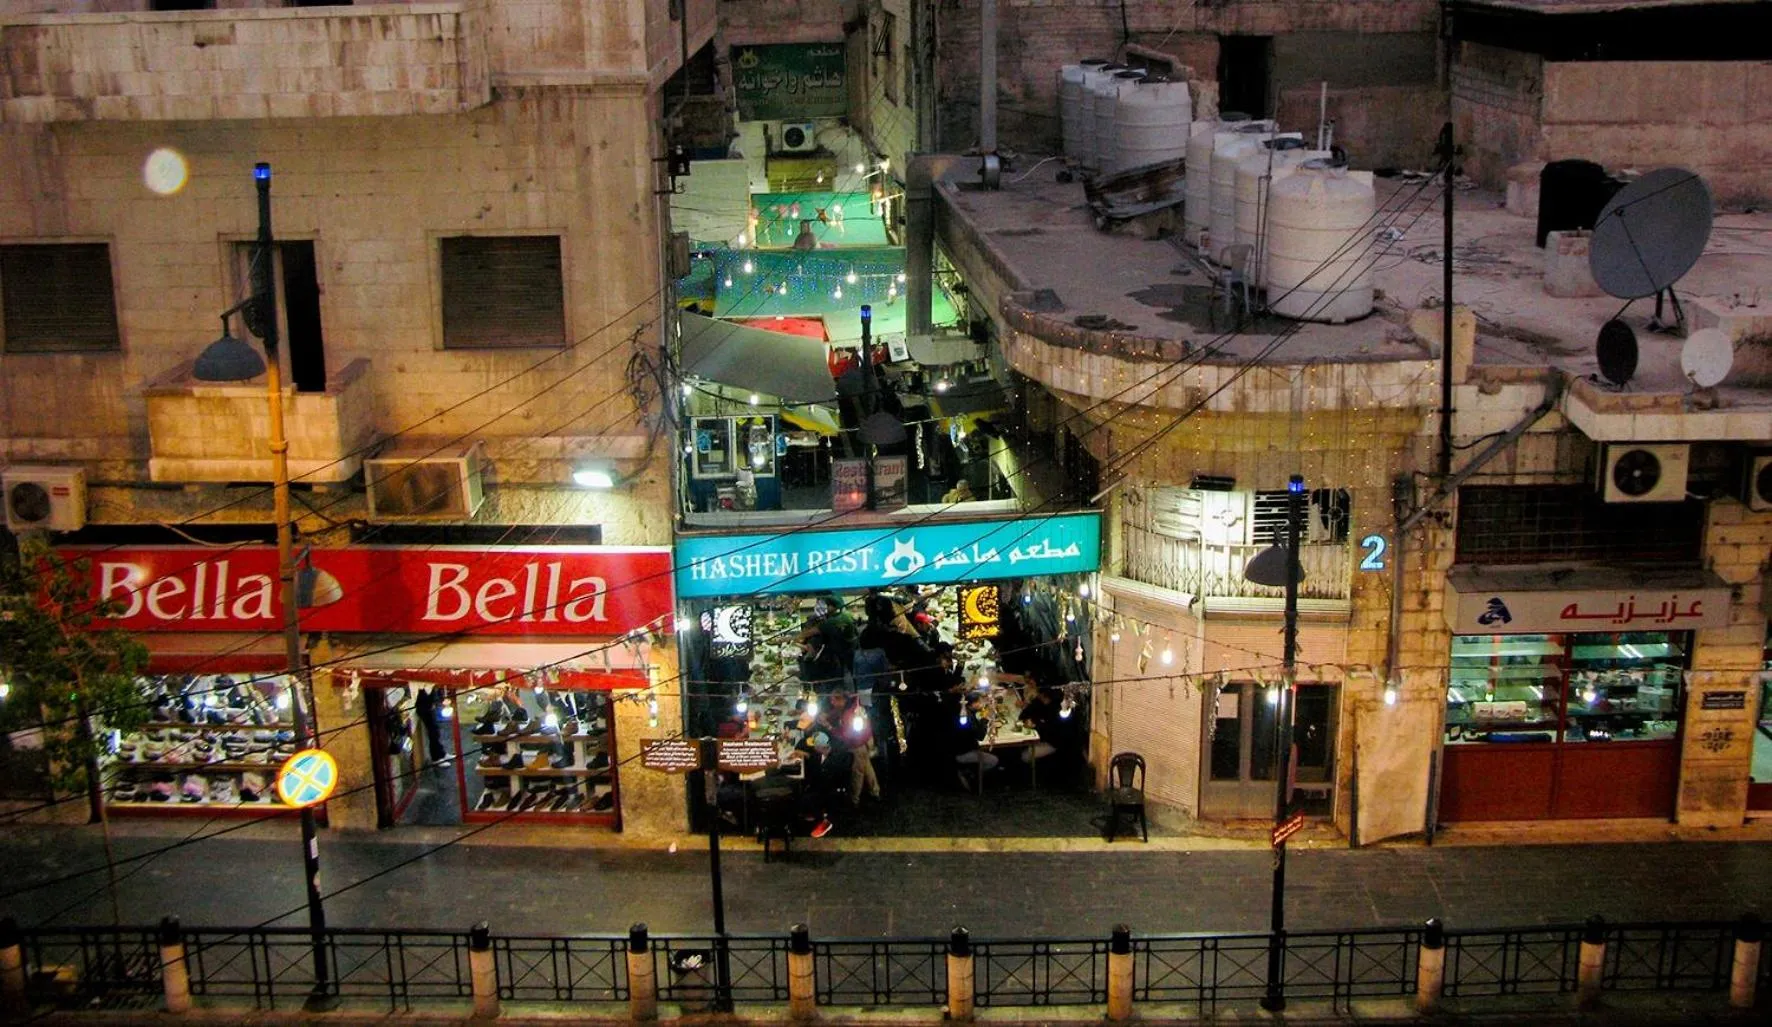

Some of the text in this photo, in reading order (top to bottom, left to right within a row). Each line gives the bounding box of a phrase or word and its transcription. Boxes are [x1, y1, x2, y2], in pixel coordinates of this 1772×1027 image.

[691, 547, 880, 581] HASHEM REST.
[932, 538, 1082, 570] مطعم هاشم
[1360, 535, 1386, 570] 2
[100, 560, 276, 621] Bella
[421, 562, 609, 623] Bella
[1560, 594, 1704, 624] عزيزيه
